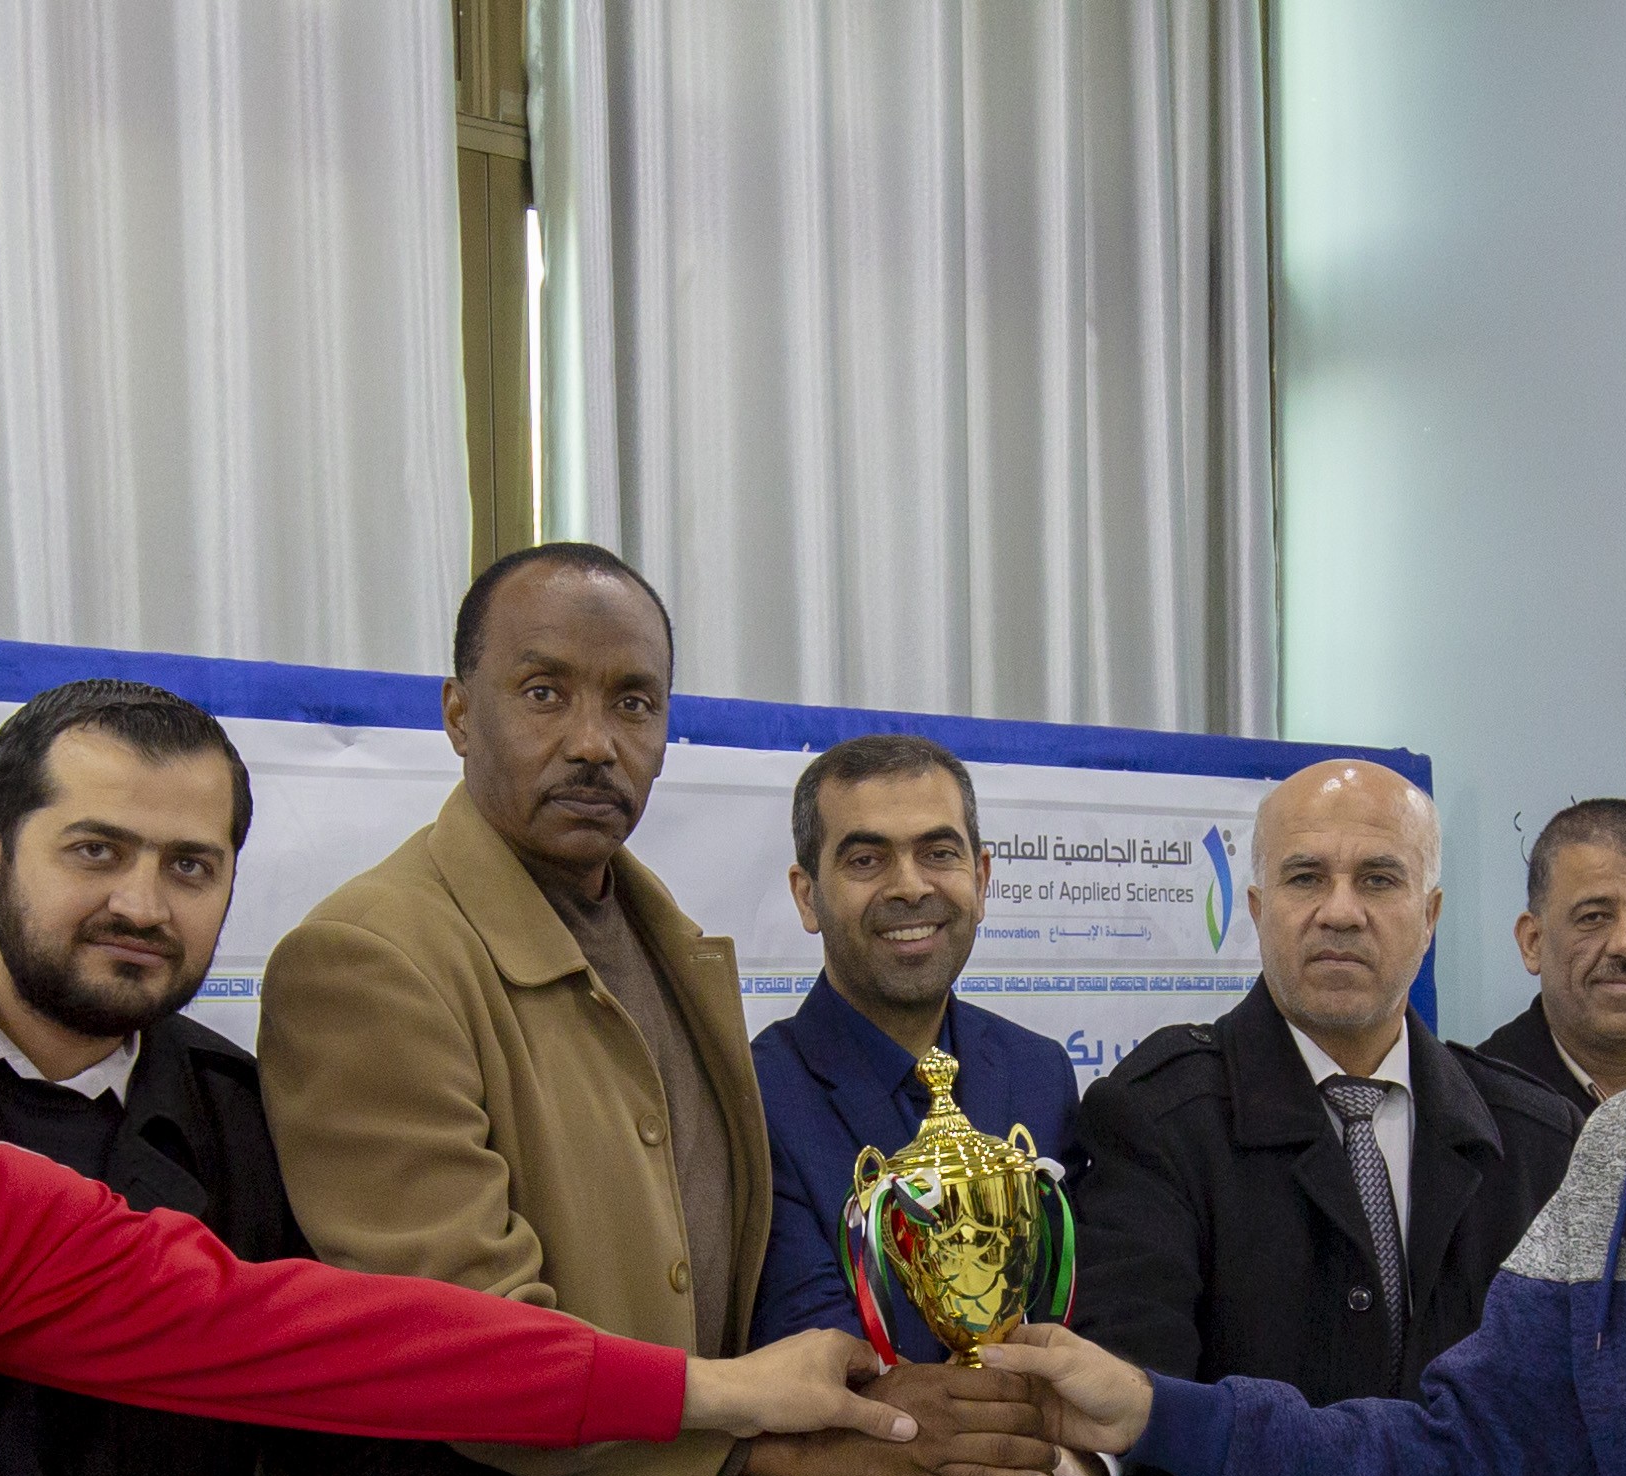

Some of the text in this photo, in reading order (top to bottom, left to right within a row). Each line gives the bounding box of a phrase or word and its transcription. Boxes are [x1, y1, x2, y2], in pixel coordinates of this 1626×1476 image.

[1053, 836, 1136, 867] الجامعية
[1141, 839, 1192, 868] الكلية
[984, 880, 1194, 905] ollege of Applied Sciences
[984, 927, 1040, 939] Innovation
